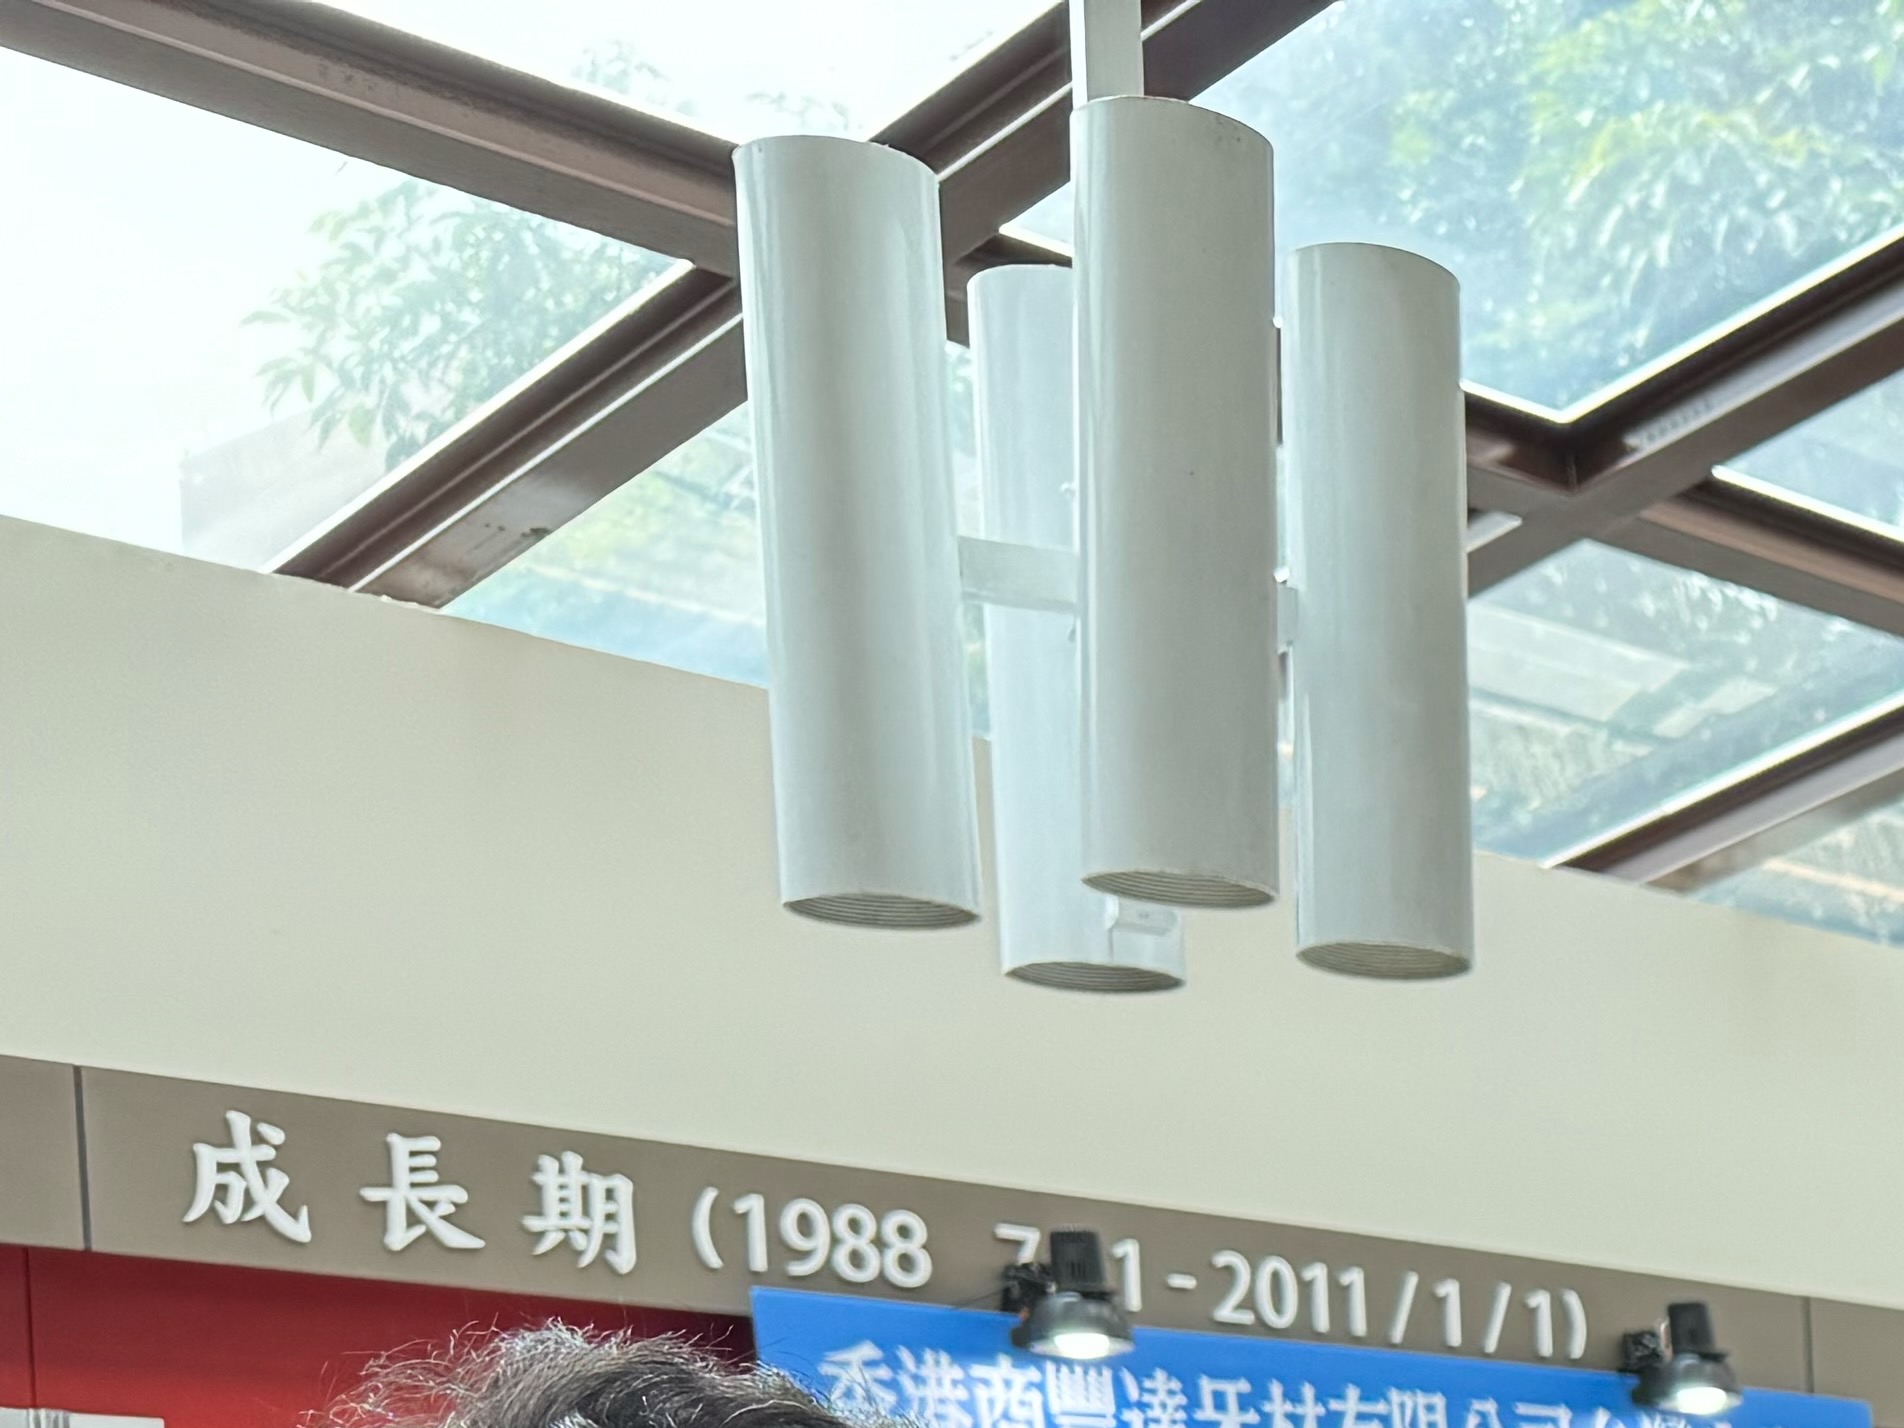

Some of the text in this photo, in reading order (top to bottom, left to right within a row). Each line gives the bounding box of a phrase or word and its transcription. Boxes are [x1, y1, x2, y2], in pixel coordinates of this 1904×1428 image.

[183, 1110, 637, 1274] 成長期
[691, 1186, 934, 1289] (1988
